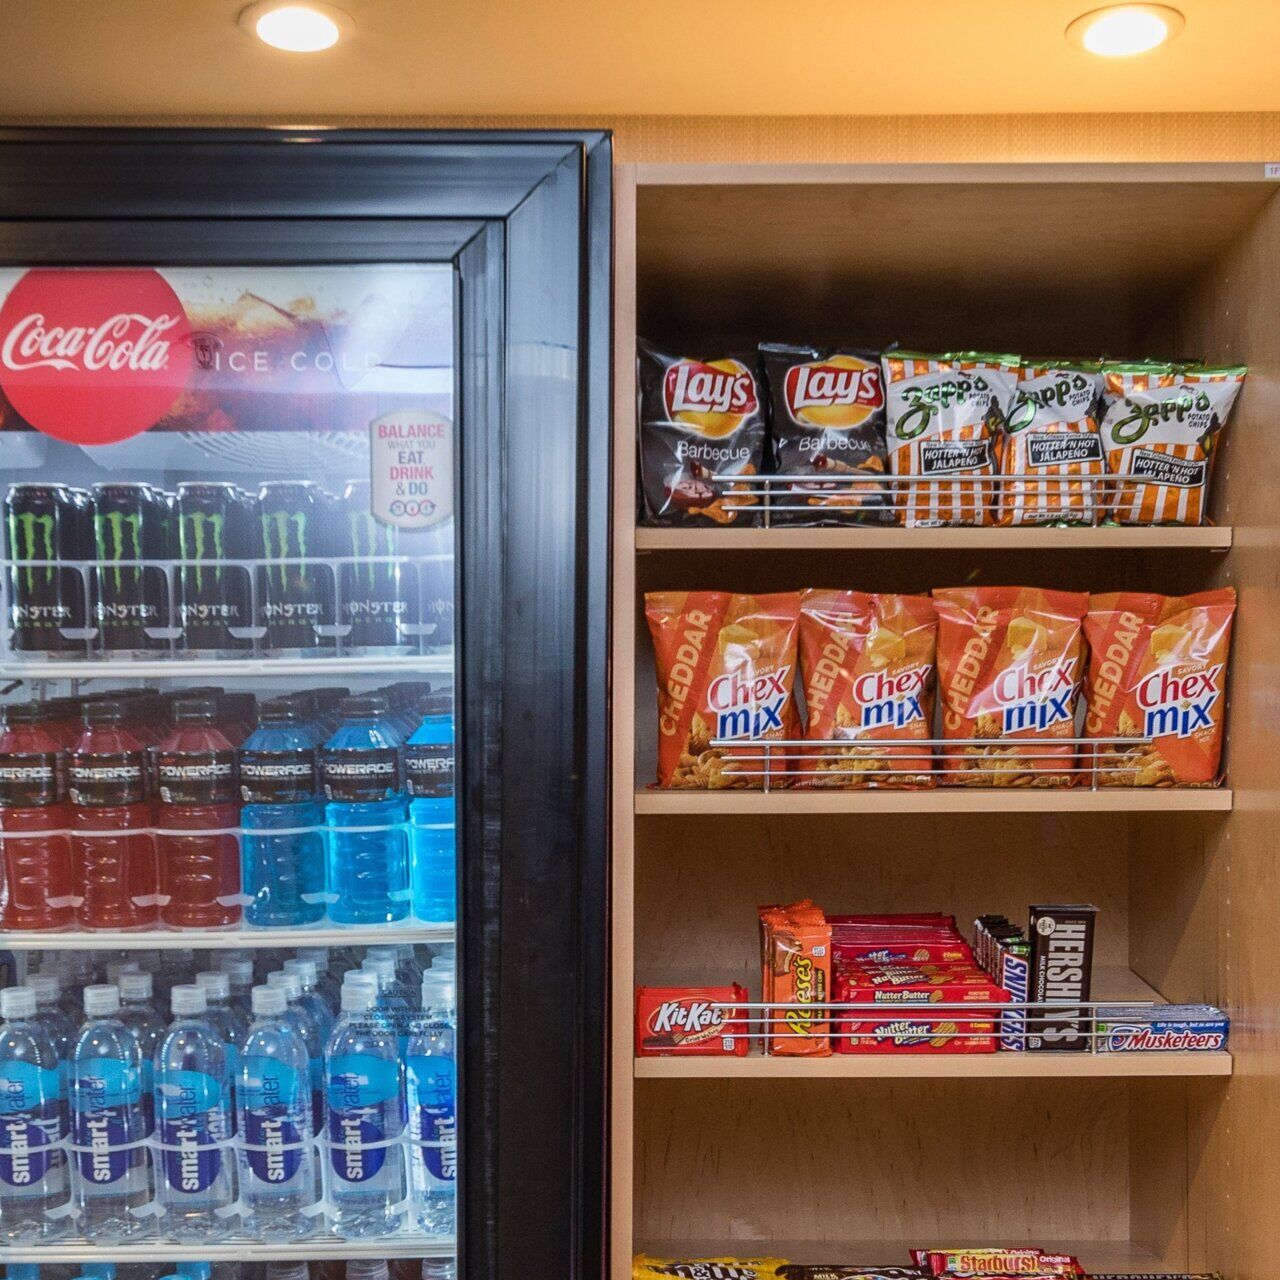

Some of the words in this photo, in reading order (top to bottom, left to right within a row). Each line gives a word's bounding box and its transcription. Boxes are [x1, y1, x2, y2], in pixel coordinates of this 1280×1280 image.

[1, 312, 180, 372] Coca-Cola
[214, 352, 268, 373] ICE
[290, 352, 389, 373] COLD
[671, 365, 750, 413] Lay's
[794, 367, 880, 410] Lay's
[969, 392, 990, 400] POTATO
[1069, 391, 1091, 400] POTATO
[1187, 413, 1210, 422] POTATO
[378, 424, 445, 438] BALANCE
[387, 440, 414, 450] WHAT
[417, 440, 436, 450] YOU
[678, 442, 750, 461] Barbecue
[799, 437, 871, 452] Barbecue
[1031, 440, 1068, 453] HOTTER
[1077, 439, 1096, 450] HOT
[398, 451, 424, 464] EAT
[924, 449, 959, 461] HOTTER
[389, 466, 434, 480] DRINK
[1135, 458, 1170, 472] HOTTER
[1179, 466, 1200, 476] HOT
[395, 482, 406, 495] &
[408, 482, 428, 495] DO
[660, 609, 713, 736] CHEDDAR
[892, 662, 920, 675] SAVORY
[945, 605, 1000, 731] CHEDDAR
[1088, 611, 1144, 733] CHEDDAR
[1177, 661, 1206, 675] SAVORY
[854, 665, 931, 703] Chex
[996, 665, 1073, 703] Chex
[1139, 670, 1217, 707] Chex
[864, 695, 924, 726] mix
[1004, 690, 1071, 733] mix
[1147, 695, 1216, 737] mix
[240, 763, 312, 776] POWERADE
[784, 955, 813, 1036] Reese's
[874, 991, 902, 1000] Nutter
[902, 991, 930, 999] Butter
[874, 1021, 911, 1040] Nutter
[1124, 1029, 1222, 1049] Musketeers
[960, 1254, 1038, 1273] Starburst
[1039, 1255, 1070, 1264] Original
